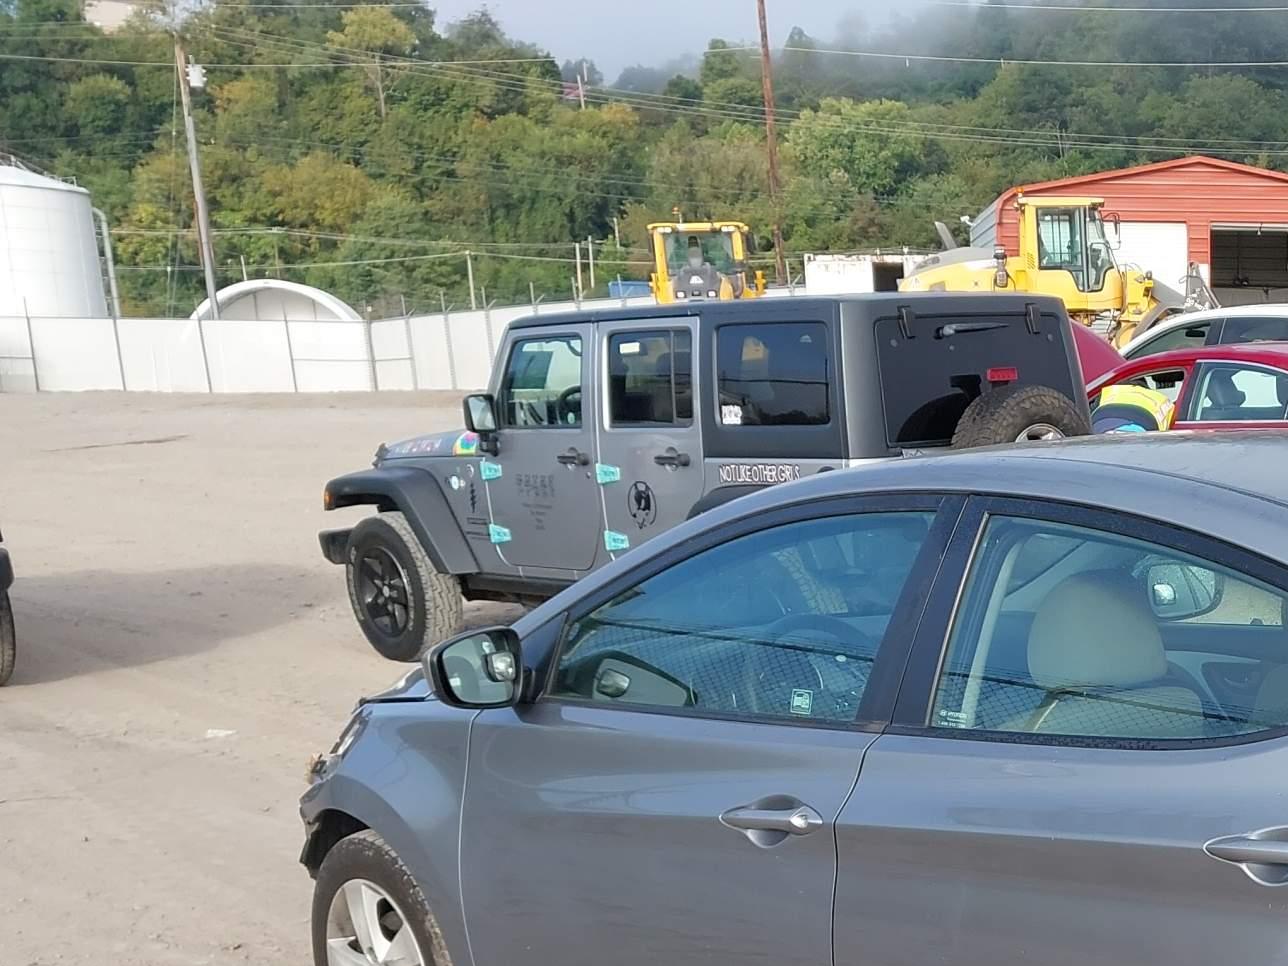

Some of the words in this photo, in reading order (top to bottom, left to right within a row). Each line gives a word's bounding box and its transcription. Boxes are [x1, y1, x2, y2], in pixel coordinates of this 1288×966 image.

[719, 465, 735, 482] NOT
[735, 465, 752, 482] LIKE
[751, 464, 778, 482] OTHER
